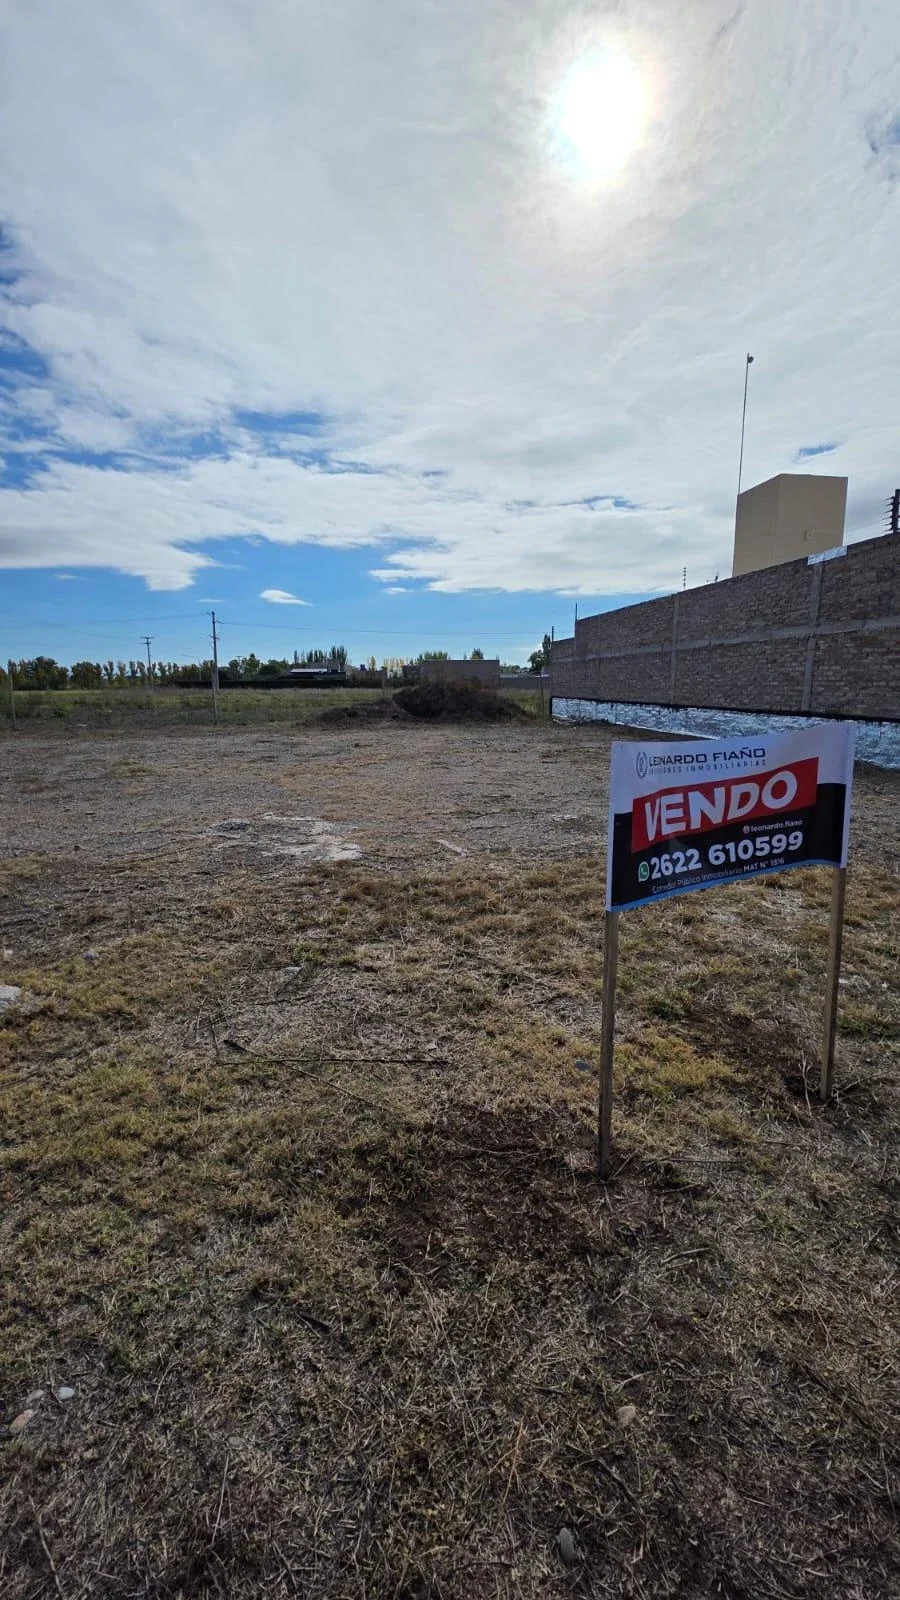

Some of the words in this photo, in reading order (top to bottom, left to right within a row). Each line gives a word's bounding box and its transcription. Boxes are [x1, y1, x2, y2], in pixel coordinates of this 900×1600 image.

[649, 754, 707, 766] LENARDO
[713, 747, 766, 762] FIAÑO
[644, 770, 798, 842] VENDO
[651, 849, 702, 880] 2622
[708, 831, 803, 865] 610599
[743, 863, 758, 872] MAT
